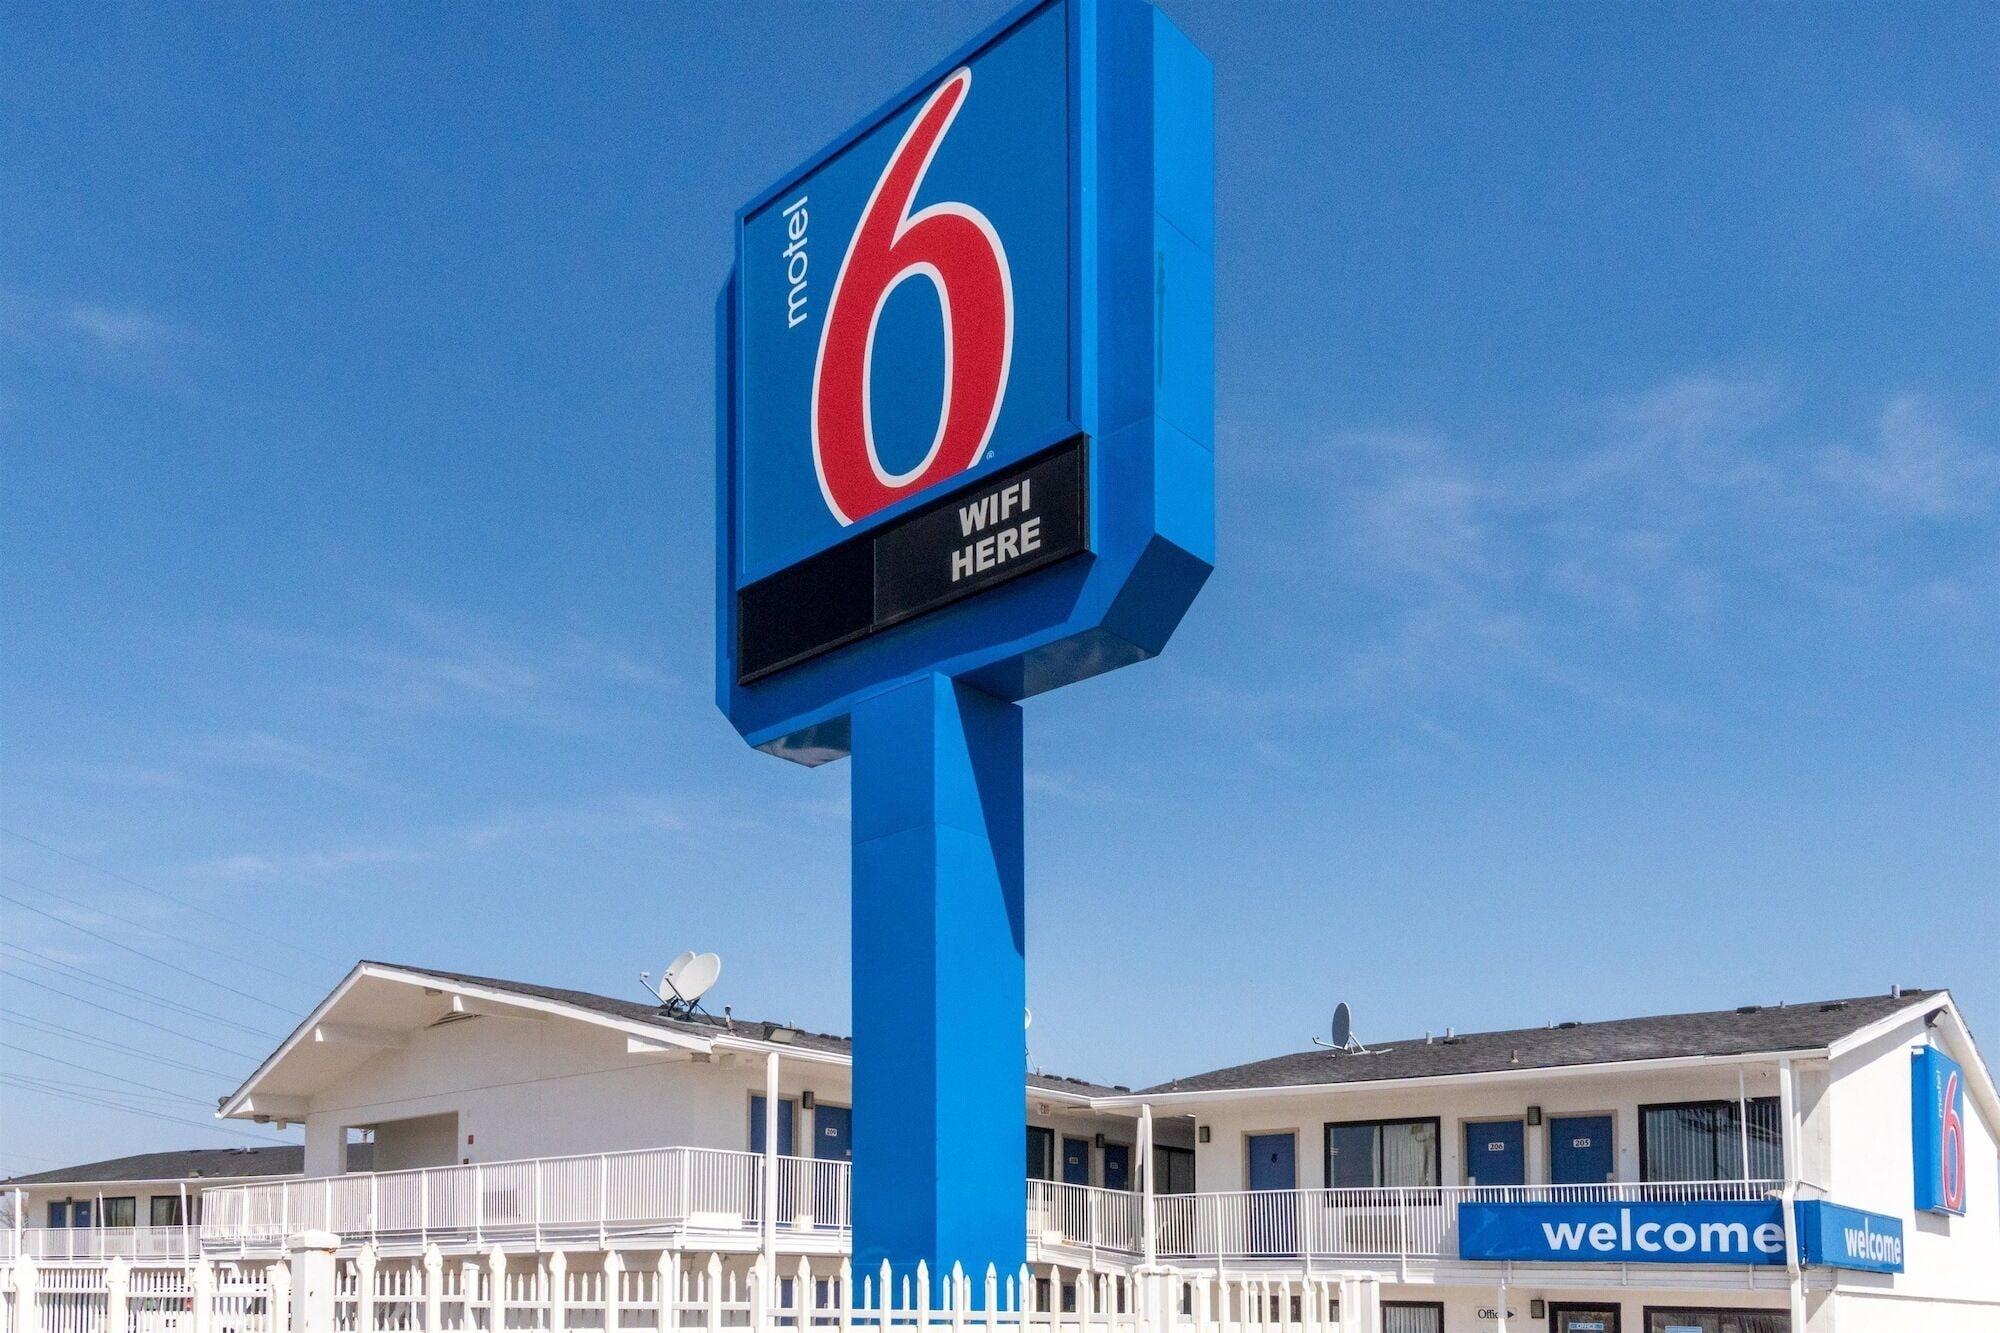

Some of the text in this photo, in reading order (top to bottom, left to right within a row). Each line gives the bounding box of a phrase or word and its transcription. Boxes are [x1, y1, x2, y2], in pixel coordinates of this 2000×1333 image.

[782, 66, 1013, 528] motel 6
[959, 478, 1030, 537] WIFI
[952, 516, 1041, 583] HERE
[1575, 1139, 1589, 1147] 205
[1941, 1070, 1964, 1210] 6
[1542, 1208, 1785, 1254] welcome
[1844, 1217, 1901, 1265] welcome
[1478, 1309, 1503, 1319] Offic
